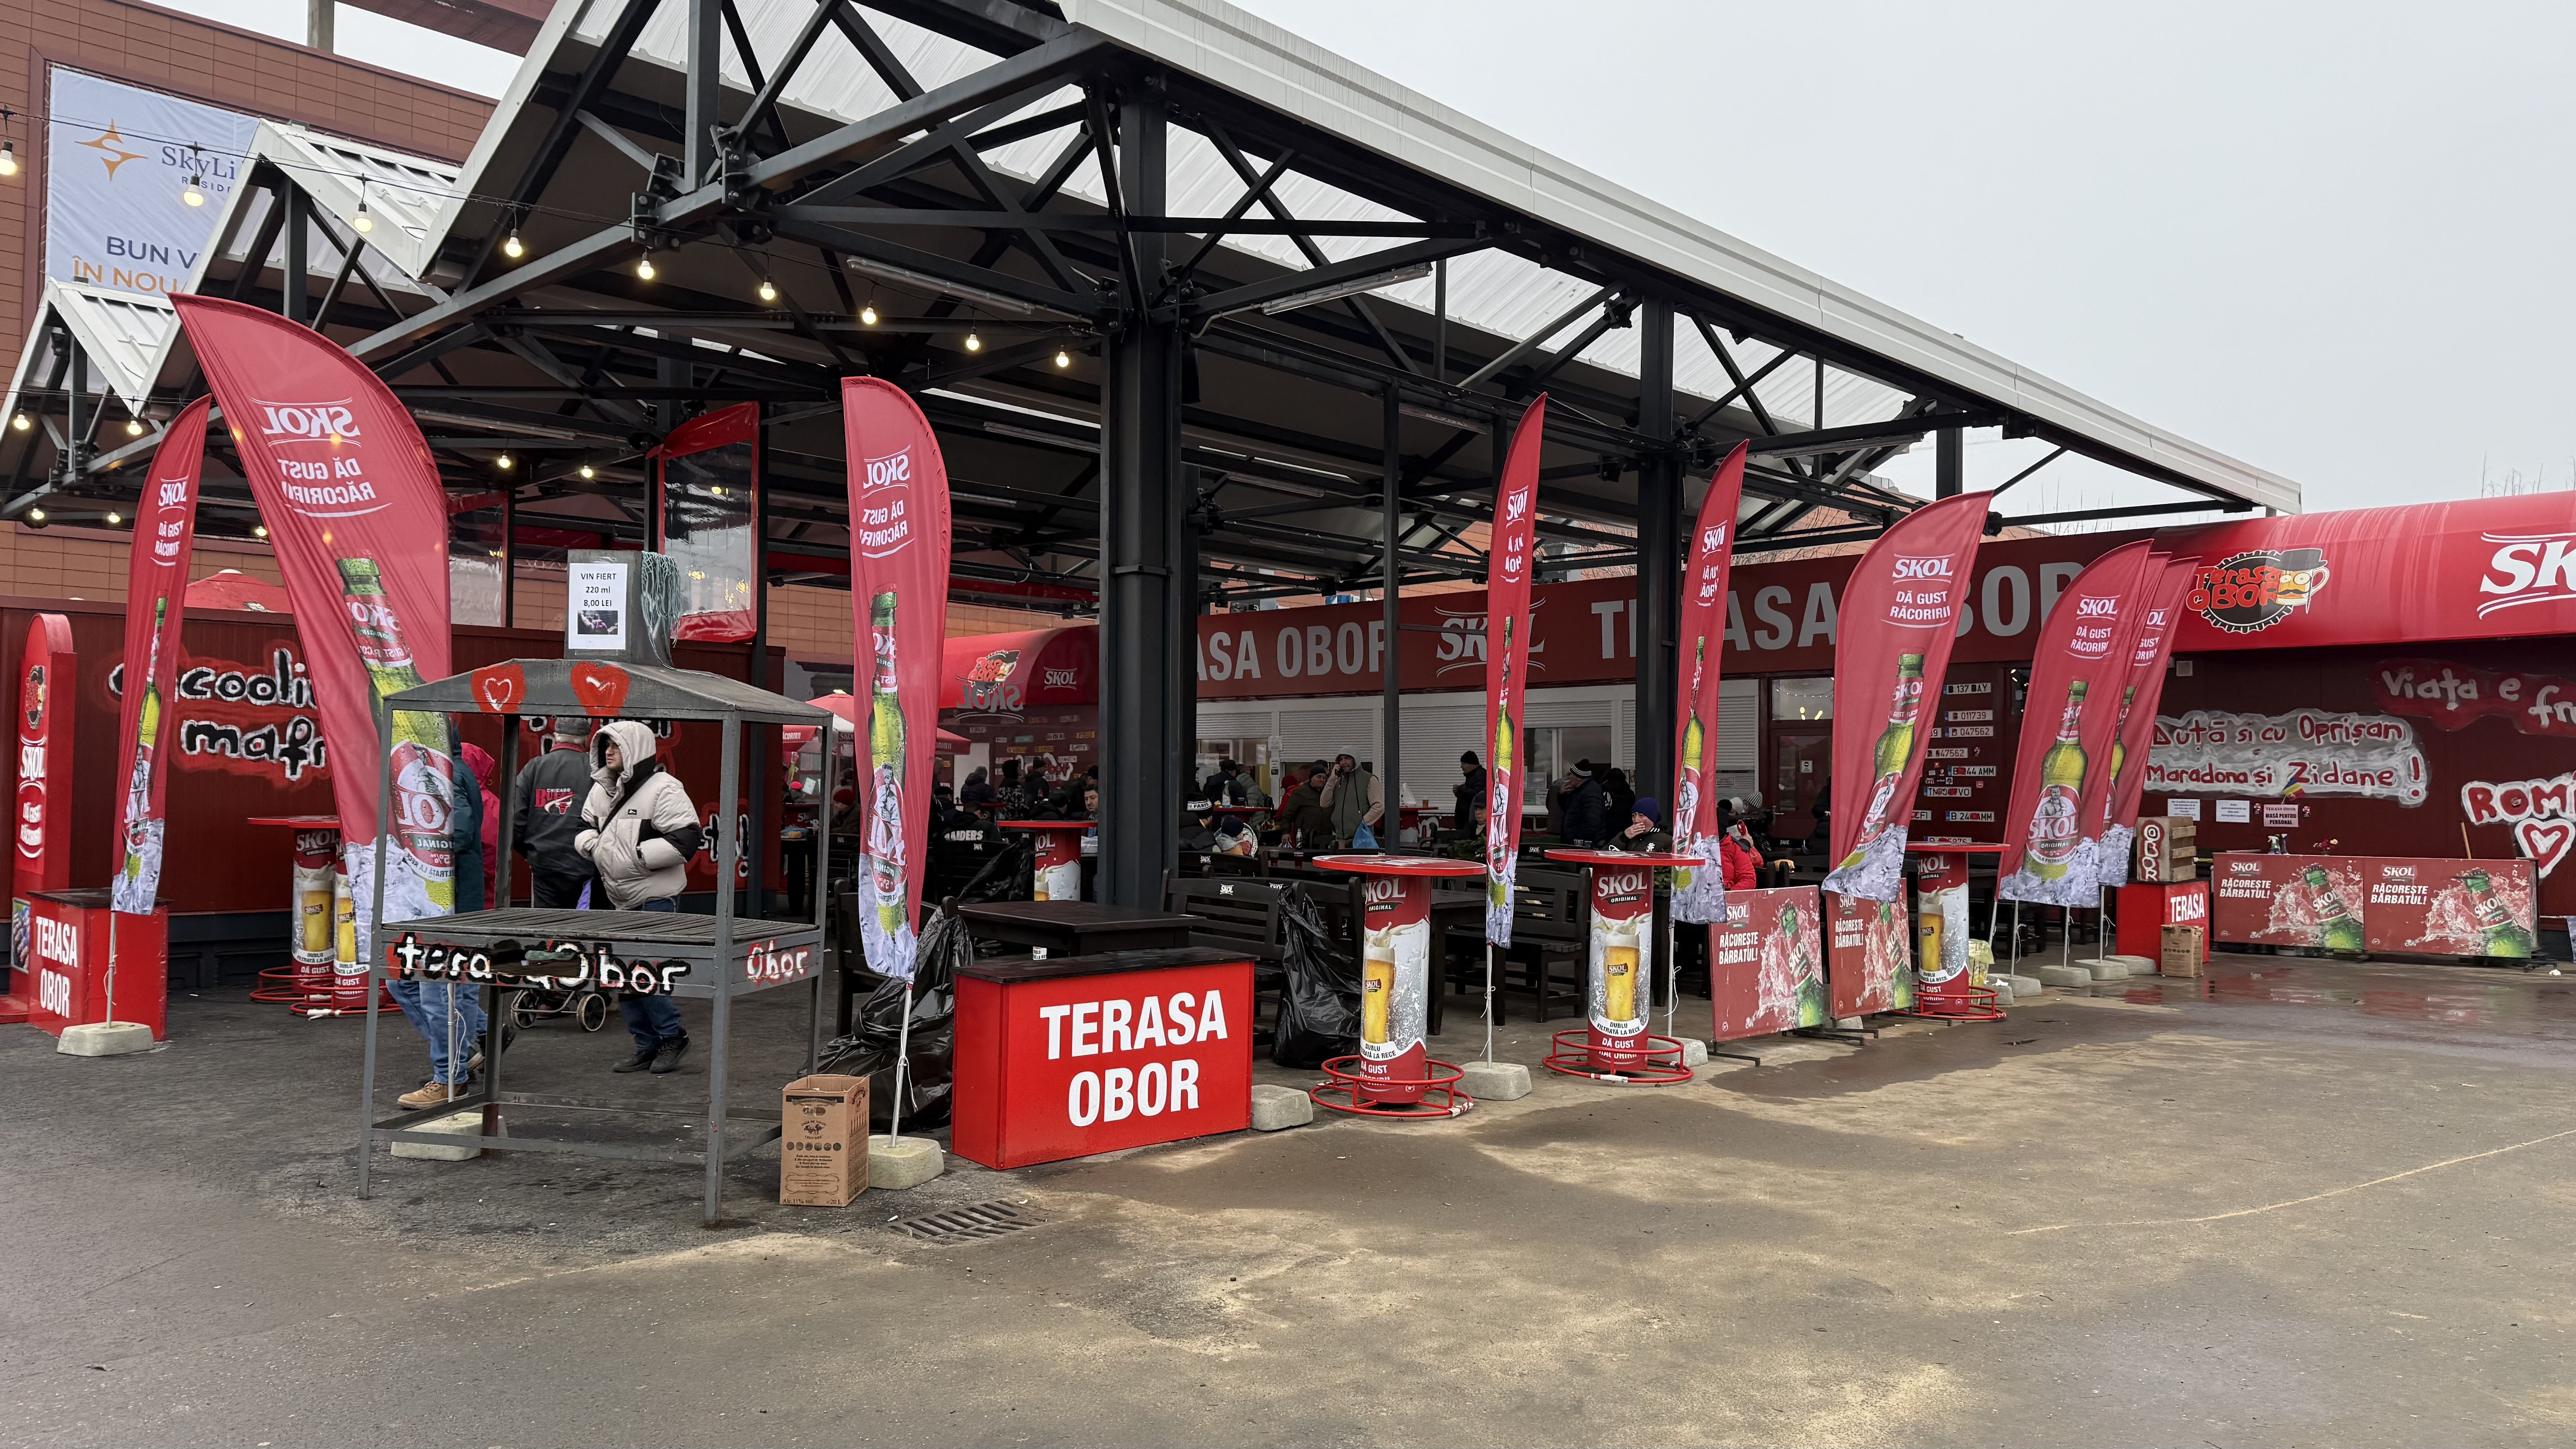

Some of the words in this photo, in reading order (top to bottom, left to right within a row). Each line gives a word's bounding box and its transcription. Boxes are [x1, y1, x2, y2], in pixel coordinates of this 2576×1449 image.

[182, 176, 231, 193] RSID
[106, 236, 168, 265] BUN
[177, 249, 201, 269] V
[72, 255, 102, 283] ÎN
[113, 267, 187, 295] NOU
[159, 481, 187, 506] SKOL
[1892, 558, 1953, 578] SKOL
[1896, 590, 1912, 603] DĂ
[1917, 591, 1947, 604] GUST
[1890, 605, 1950, 620] RĂCORIRII
[2076, 598, 2118, 615] SKOL
[2146, 611, 2167, 626] OL
[1437, 612, 1545, 661] SKL
[2076, 626, 2087, 637] DĂ
[2089, 627, 2111, 639] GUST
[2070, 639, 2109, 653] RĂCORIR
[1044, 671, 1076, 685] SKOL
[1971, 684, 1987, 692] BAY
[2499, 678, 2521, 702] e
[1961, 712, 1986, 720] 011739
[1960, 728, 1990, 736] 047562
[2261, 727, 2286, 741] cu
[2147, 763, 2248, 784] Maradona
[2288, 761, 2393, 785] Zidane
[2465, 780, 2576, 823] ROM
[2028, 815, 2079, 840] SKOL
[2230, 862, 2260, 872] SKOL
[2383, 866, 2415, 877] SKOL
[1598, 871, 1647, 897] SKOL
[1727, 904, 1749, 920] SKOL
[2171, 892, 2205, 923] TERASA
[36, 915, 78, 968] TERASA
[747, 939, 808, 982] Obor
[312, 965, 331, 975] GUST
[1608, 964, 1627, 973] SKOL
[342, 977, 360, 986] GUST
[40, 968, 69, 1019] OBOR
[1040, 989, 1228, 1060] TERASA
[1597, 1023, 1619, 1035] FILTRATĂ
[1629, 1026, 1641, 1035] RECE
[1602, 1037, 1613, 1048] DĂ
[1615, 1040, 1634, 1049] GUST
[1381, 1050, 1397, 1059] RECE
[1368, 1064, 1388, 1074] GUST
[1068, 1058, 1199, 1127] OBOR
